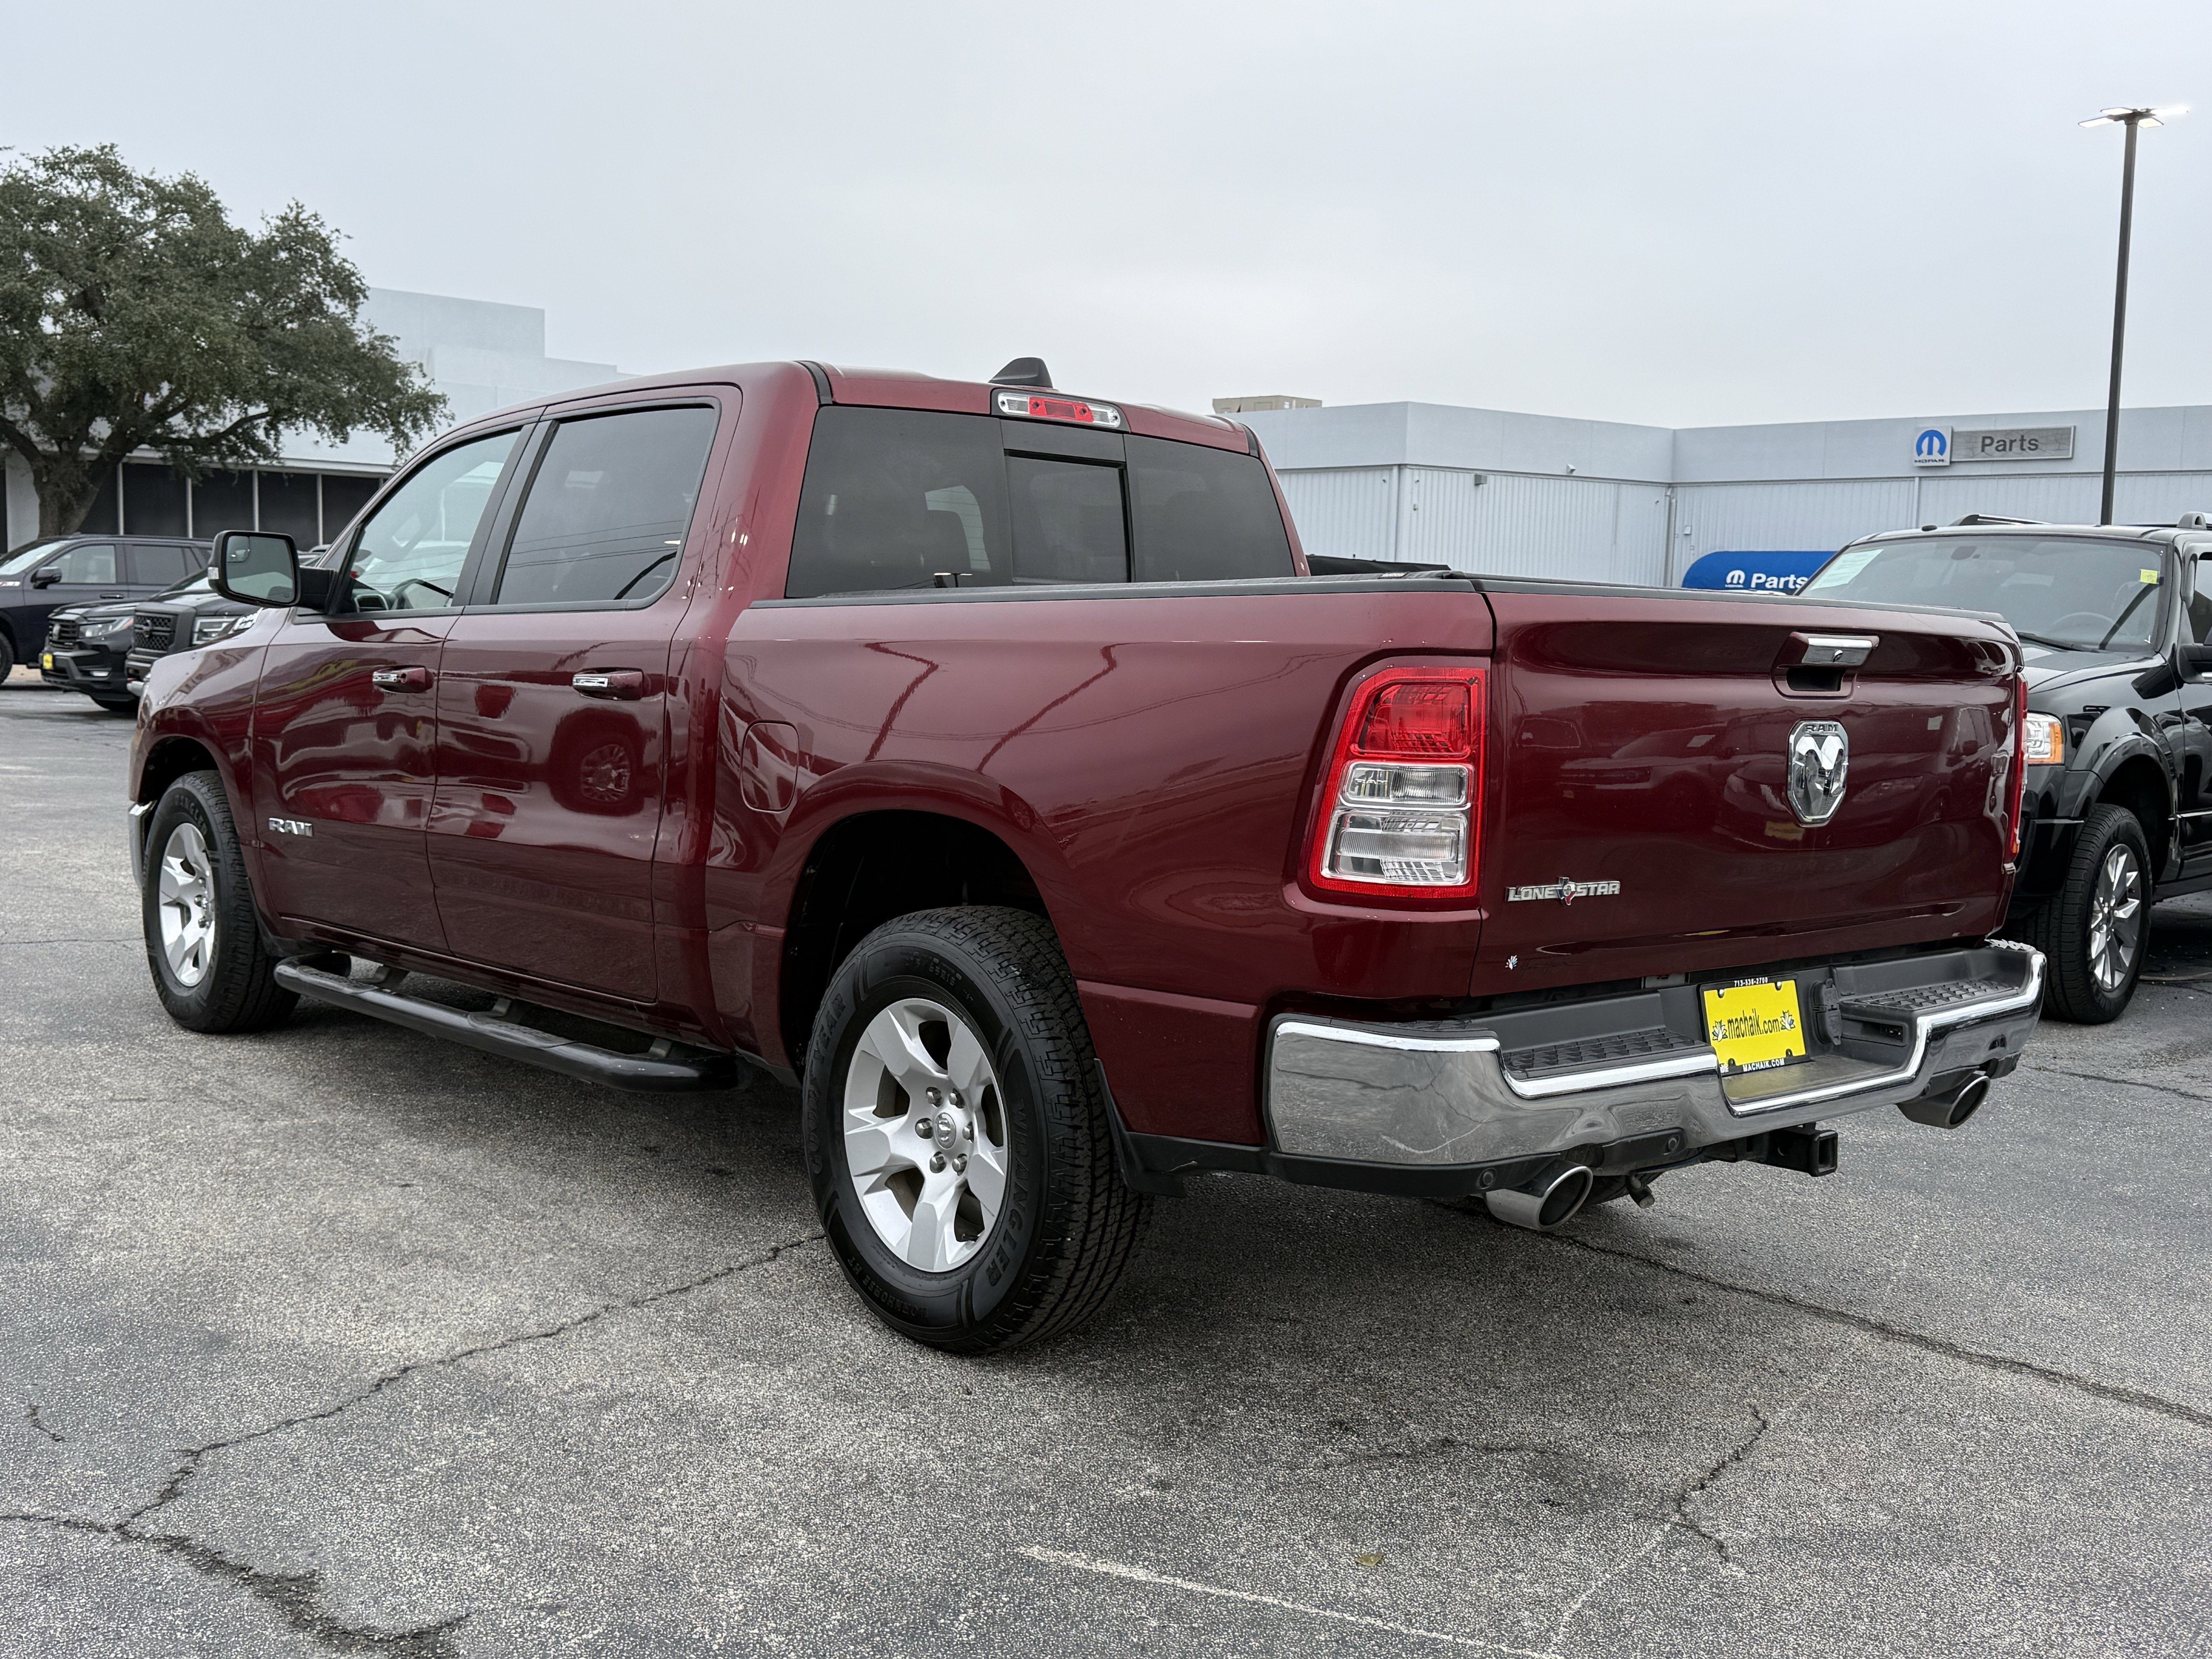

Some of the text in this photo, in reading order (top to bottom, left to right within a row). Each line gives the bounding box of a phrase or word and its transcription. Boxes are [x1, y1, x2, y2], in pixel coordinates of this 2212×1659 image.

[1981, 434, 2039, 452] Parts
[1750, 573, 1809, 588] Parts
[1805, 724, 1838, 732] RAM
[269, 817, 313, 837] RAM
[1506, 881, 1621, 902] LONE STAR
[1727, 1008, 1781, 1039] machaik.com
[1742, 1058, 1785, 1072] MACHAIK.COM
[986, 1099, 1029, 1286] WRANGLER
